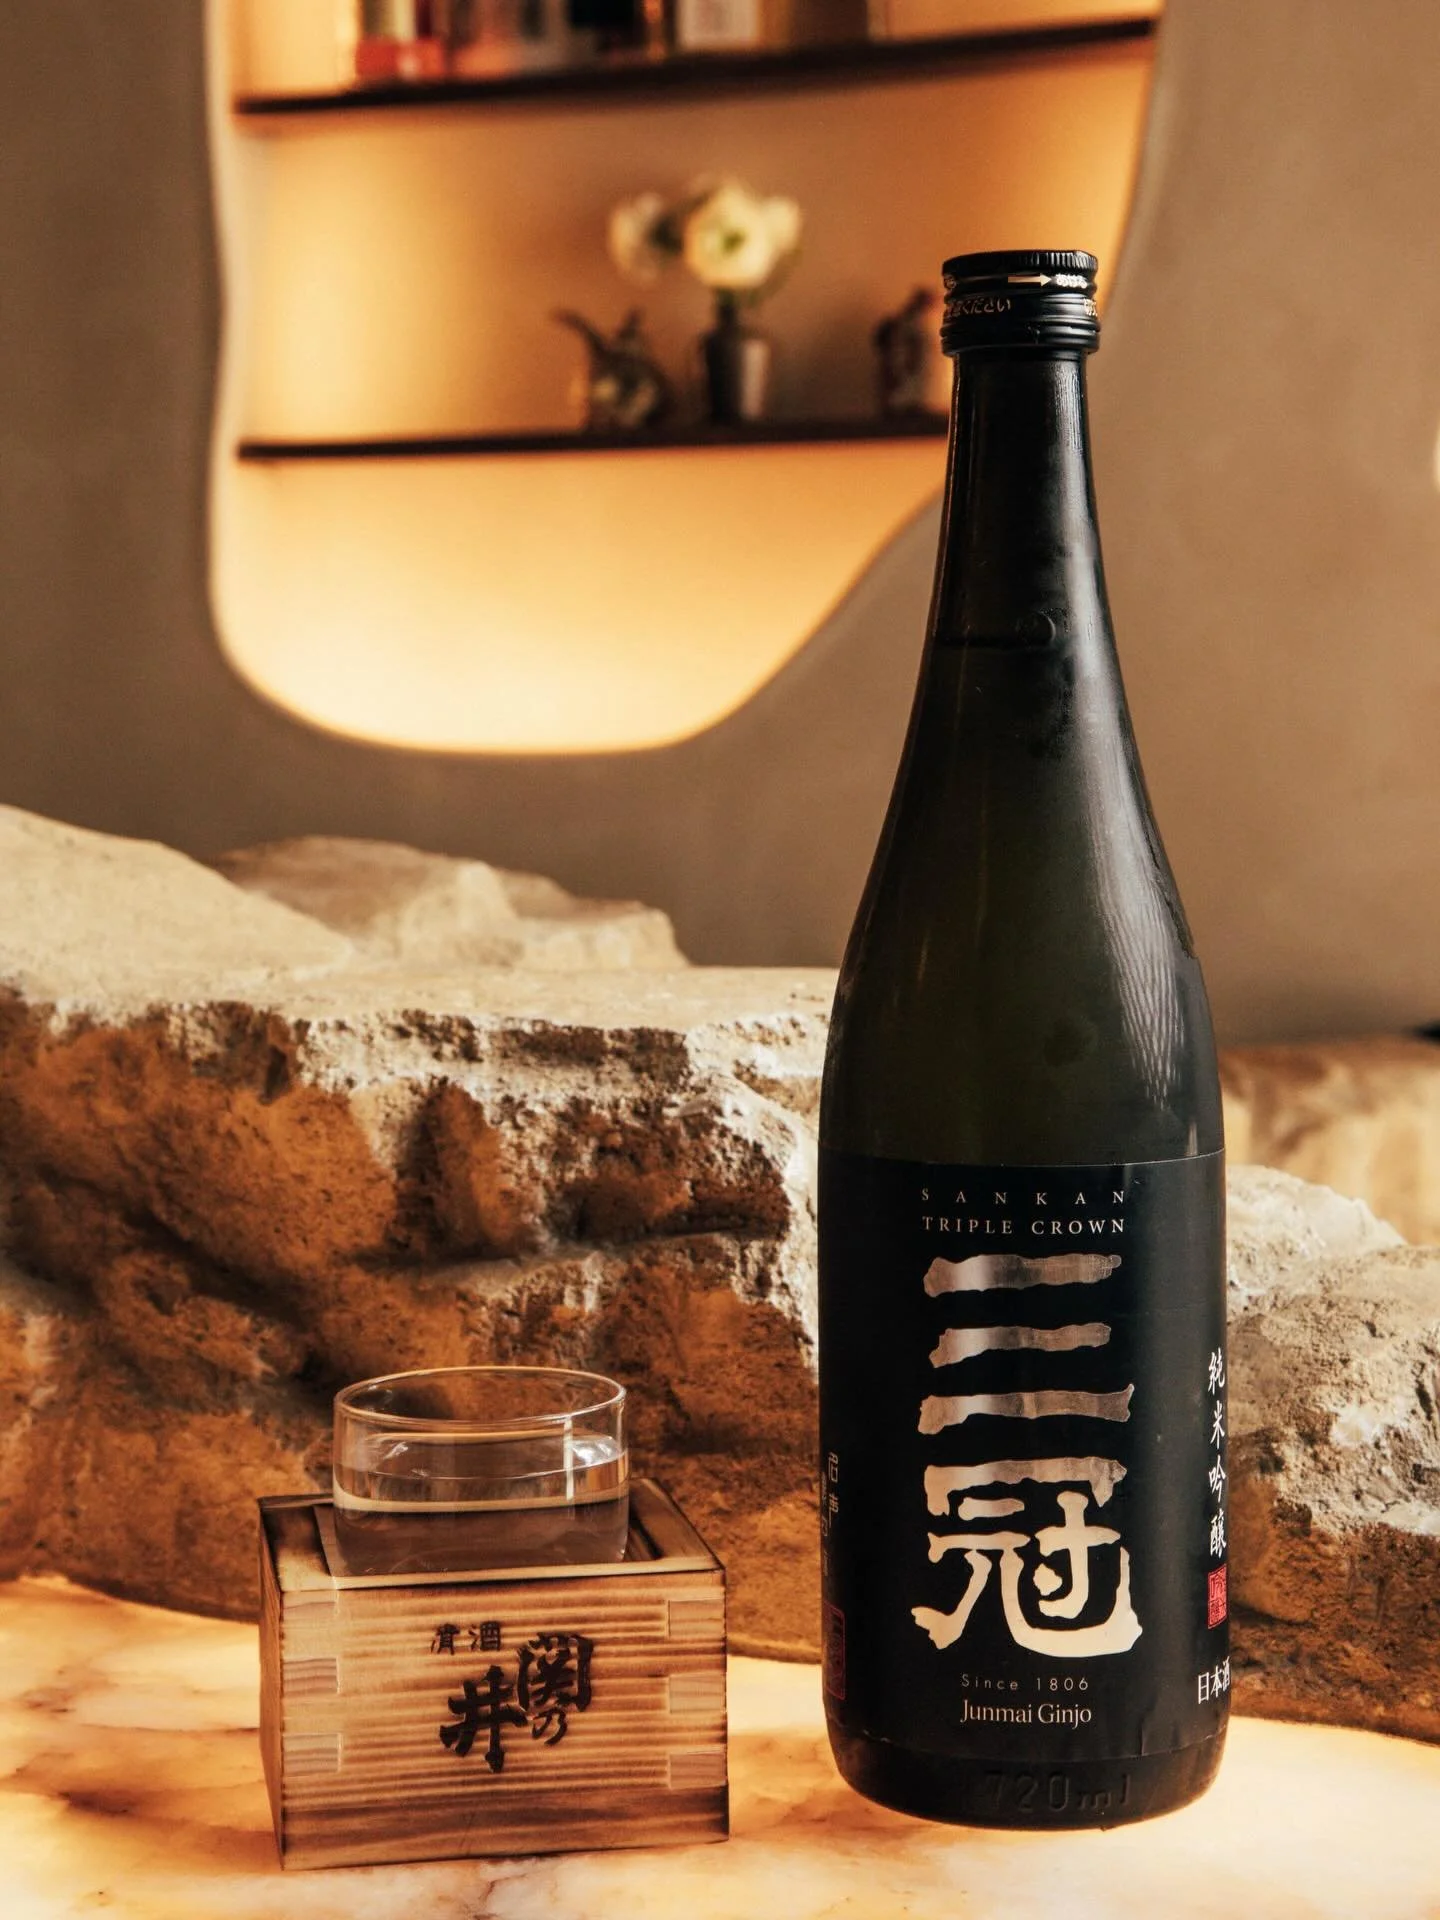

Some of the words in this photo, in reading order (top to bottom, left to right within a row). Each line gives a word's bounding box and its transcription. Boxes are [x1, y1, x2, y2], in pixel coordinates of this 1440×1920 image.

[922, 1187, 1125, 1206] SANKAN
[922, 1216, 1013, 1235] TRIPLE
[1031, 1218, 1125, 1235] CROWN
[910, 1253, 1143, 1658] 三冠
[961, 1673, 1019, 1691] Since
[1035, 1676, 1090, 1692] 1806
[960, 1699, 1033, 1724] Junmai
[1037, 1703, 1092, 1730] Ginjo
